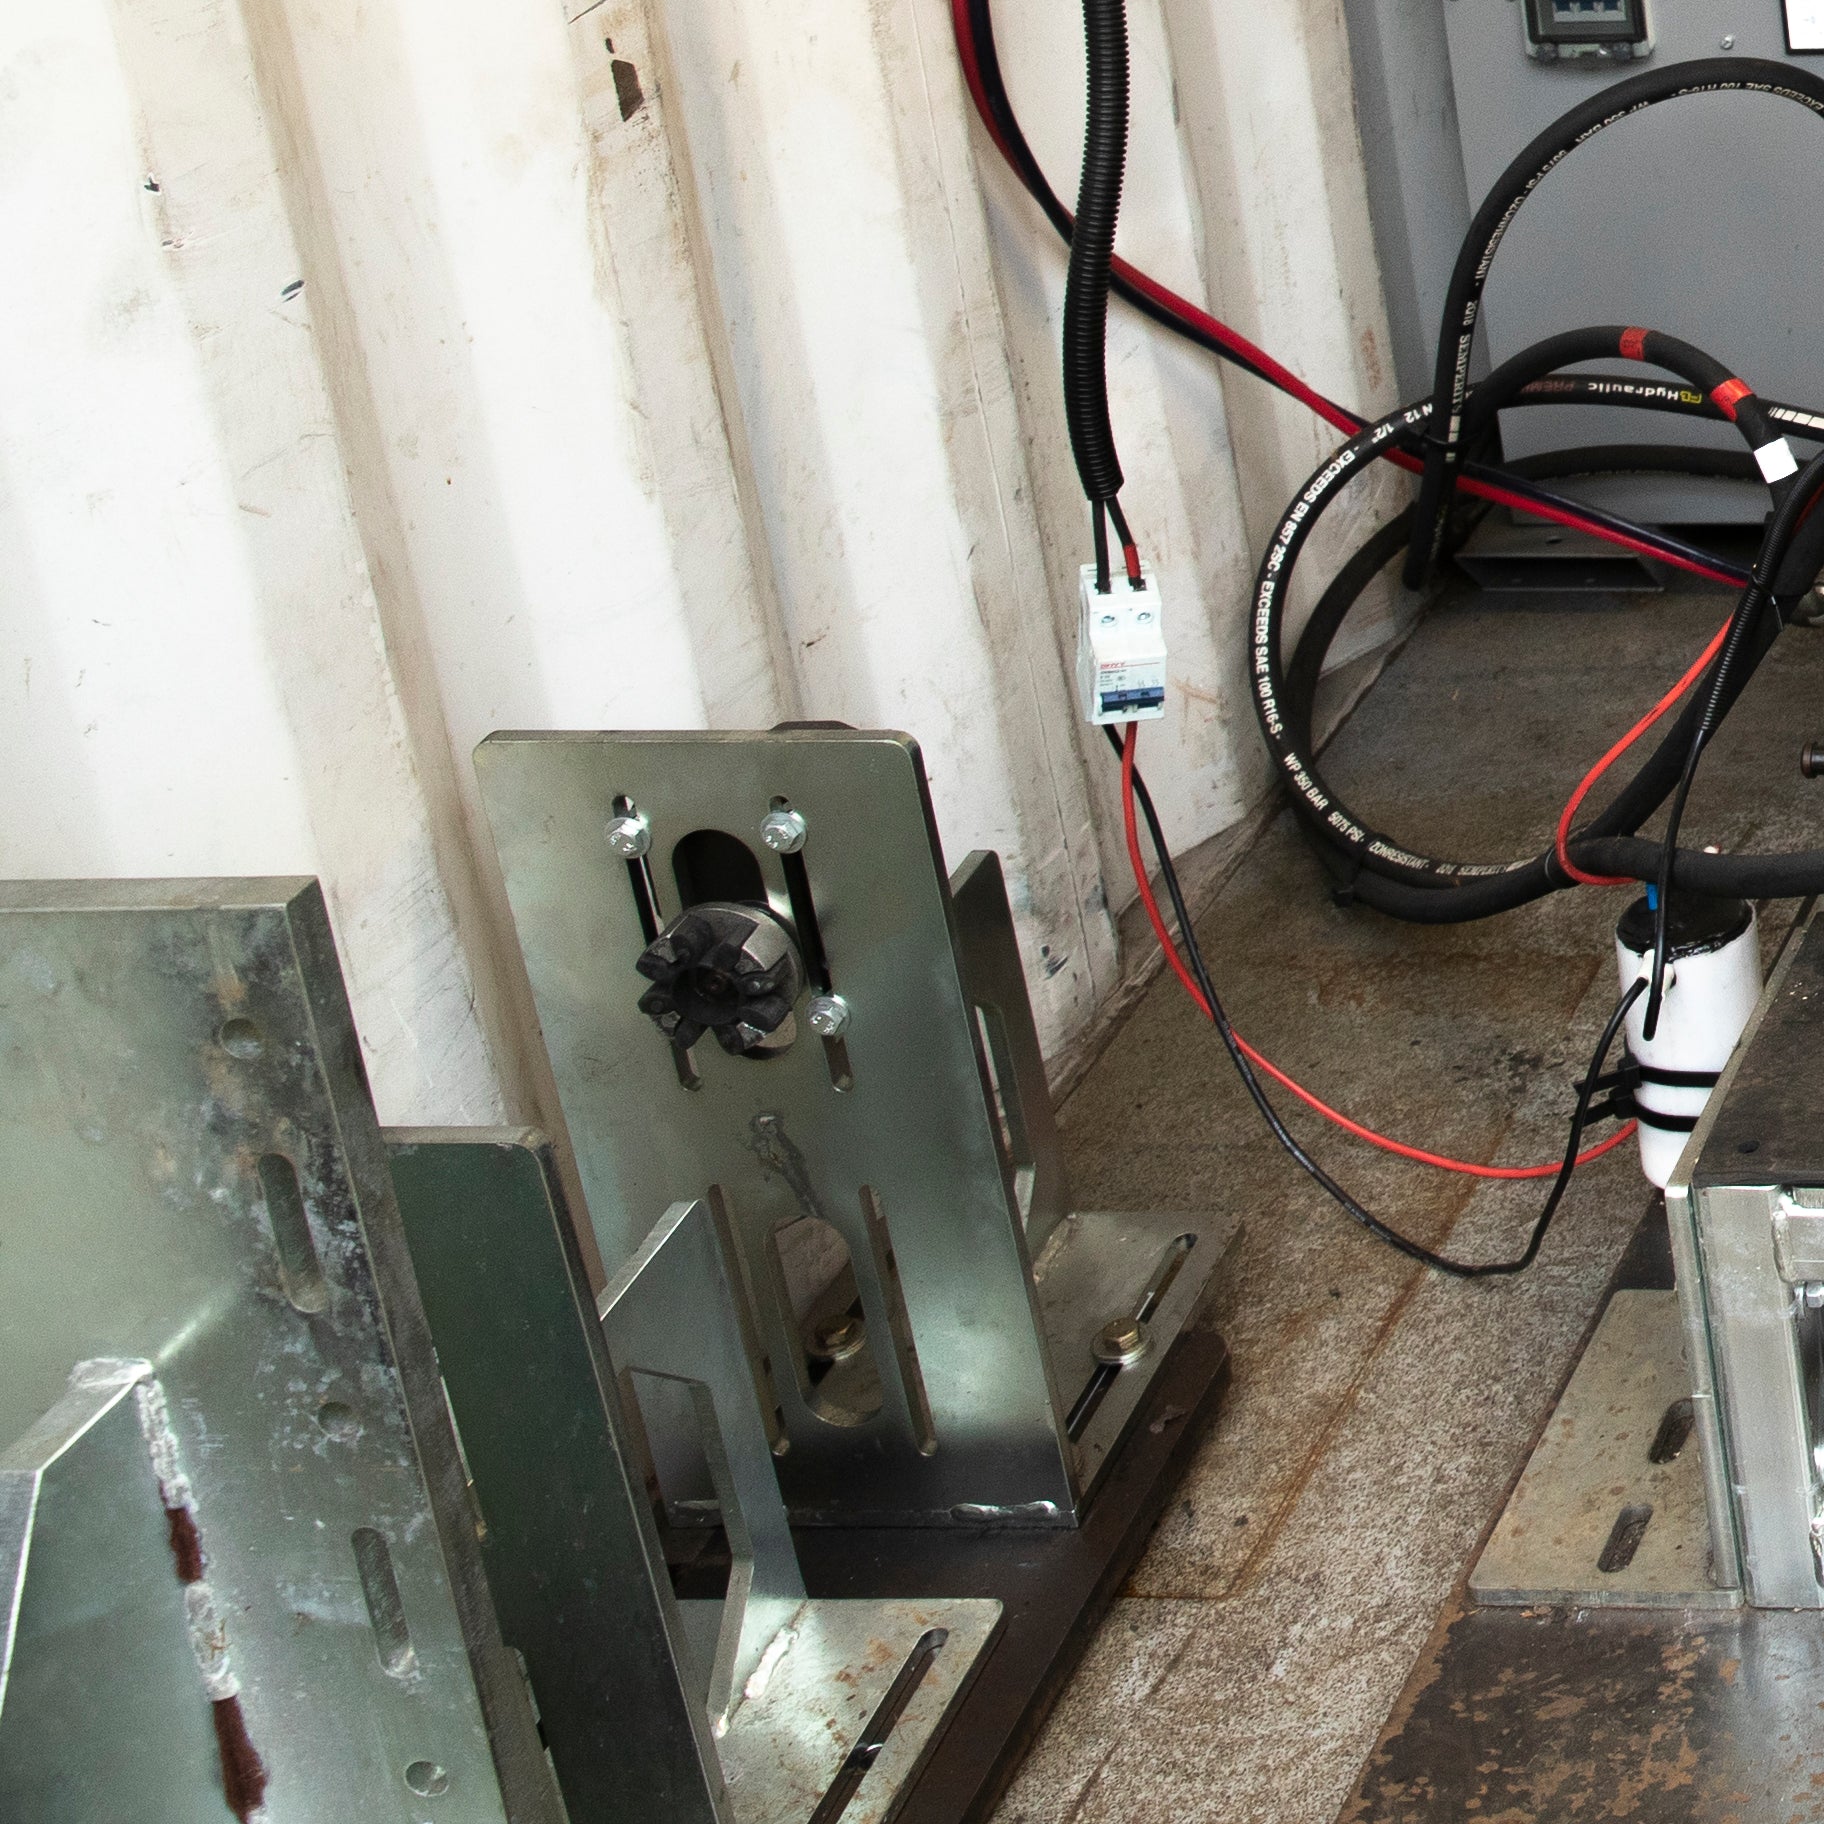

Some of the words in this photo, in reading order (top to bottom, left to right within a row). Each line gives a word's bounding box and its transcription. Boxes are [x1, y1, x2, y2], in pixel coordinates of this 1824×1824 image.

[1587, 381, 1679, 402] Hydraulic
[1303, 448, 1357, 504] EXCEEDS
[1289, 500, 1310, 523] EN
[1279, 518, 1299, 546] 857
[1267, 544, 1288, 572] 2SC
[1255, 580, 1276, 644] EXCEEDS
[1255, 644, 1270, 675] SAE
[1257, 675, 1273, 698] 100
[1283, 751, 1300, 773] WP
[1293, 769, 1315, 792] 350
[1305, 785, 1330, 812] BAR
[1327, 810, 1352, 835] 5075
